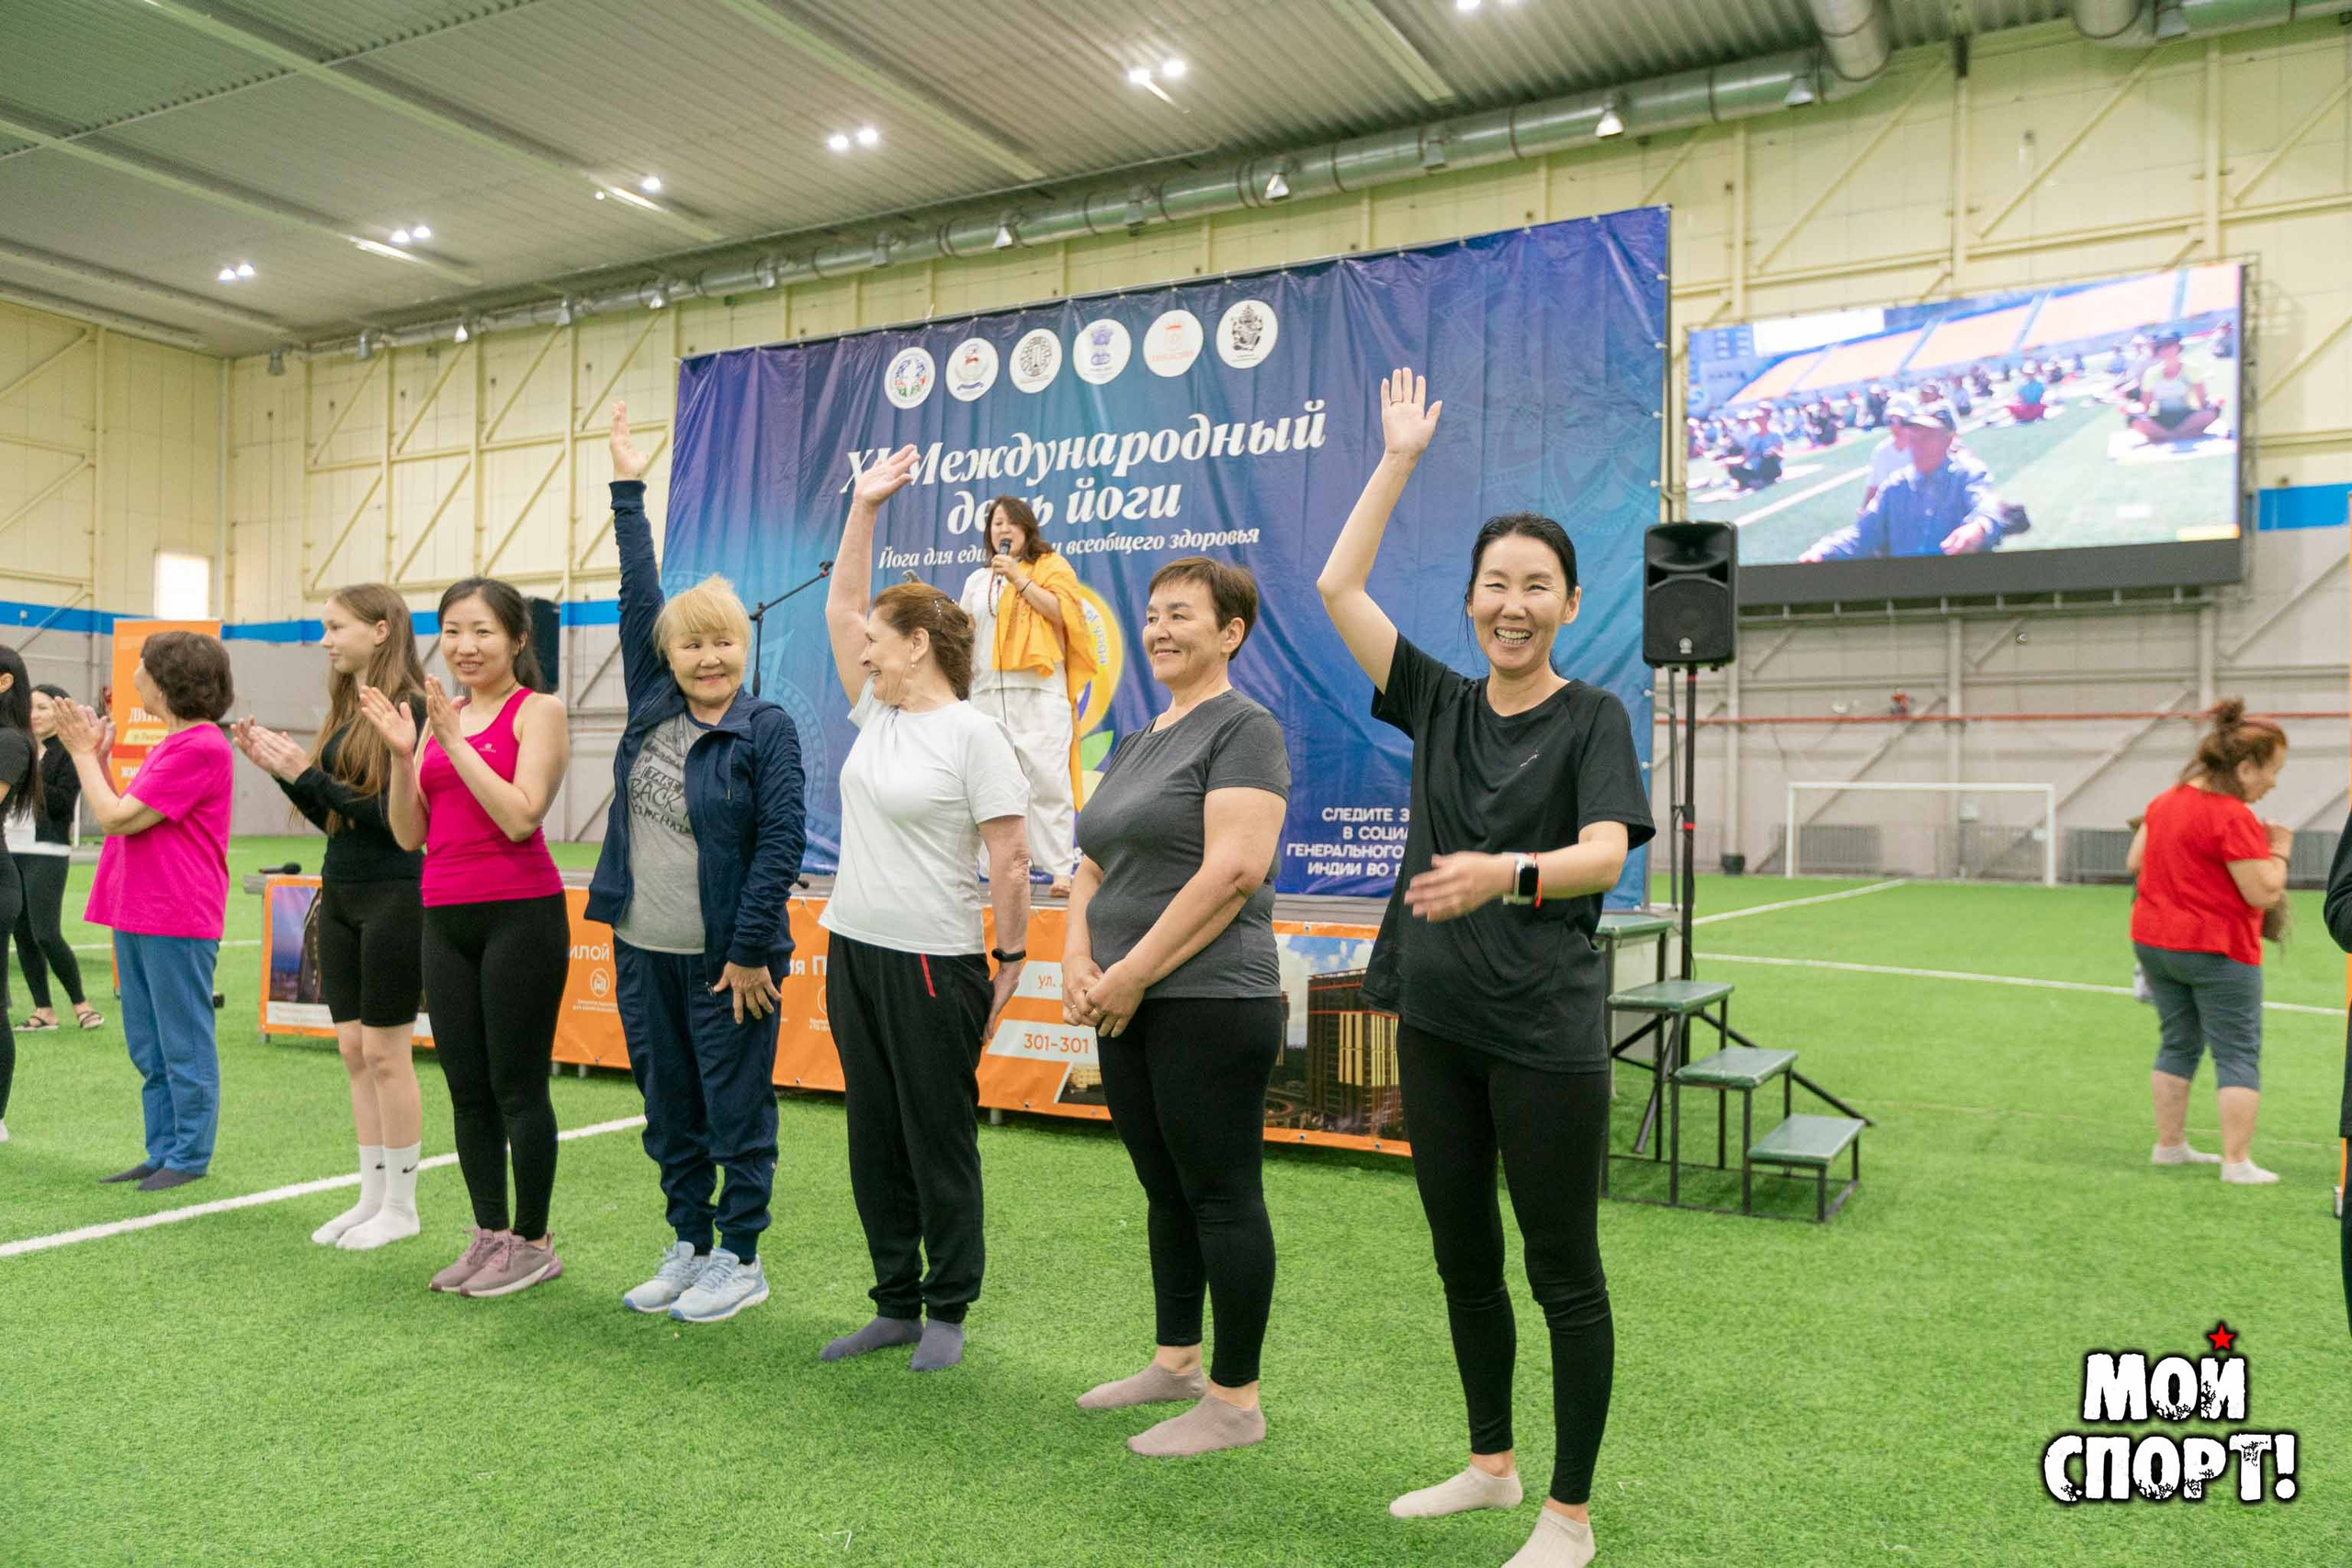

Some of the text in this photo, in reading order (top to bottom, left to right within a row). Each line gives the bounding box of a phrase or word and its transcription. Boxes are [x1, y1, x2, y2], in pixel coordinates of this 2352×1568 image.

[910, 399, 1327, 487] Международный
[947, 477, 1182, 535] деь йоги
[878, 546, 920, 569] Йога
[923, 547, 953, 566] для
[957, 544, 987, 564] еди
[1067, 532, 1165, 556] всеобщего
[1170, 527, 1261, 552] здоровья
[1321, 807, 1410, 822] СЛЕДИТЕ З
[1342, 826, 1408, 840] В СОЦИ
[1286, 843, 1405, 859] ГЕНЕРАЛЬНОГО
[1307, 862, 1362, 876] ИНДИИ
[1366, 863, 1390, 876] ВО
[569, 942, 611, 963] ИЛОЙ
[1038, 974, 1057, 989] ул.
[1023, 1032, 1091, 1055] 301-301
